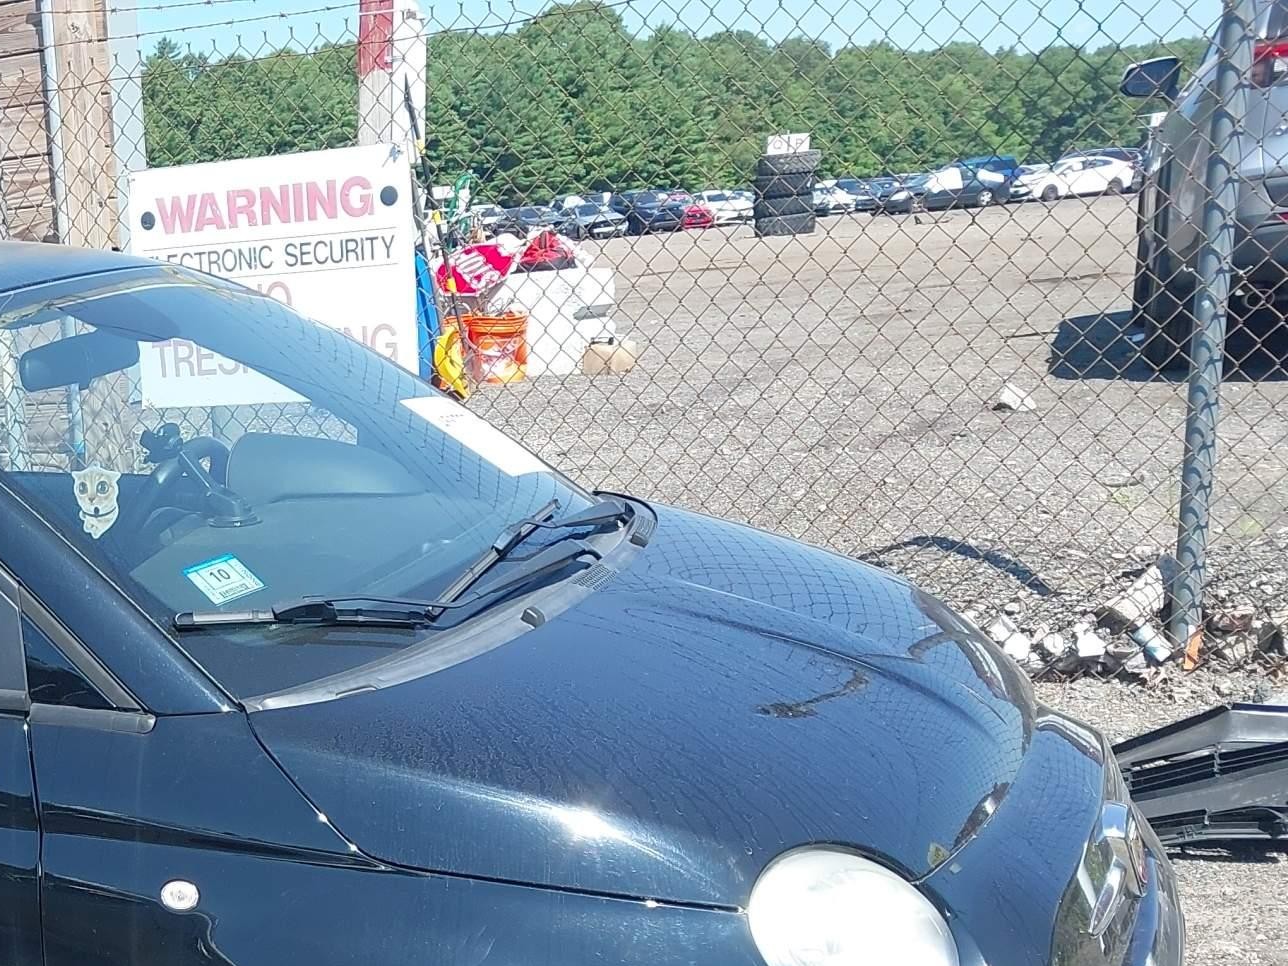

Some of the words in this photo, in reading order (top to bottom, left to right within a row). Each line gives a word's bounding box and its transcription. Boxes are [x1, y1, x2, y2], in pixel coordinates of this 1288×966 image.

[155, 175, 375, 234] WARNING
[284, 234, 395, 267] SECURITY
[209, 568, 231, 583] 10
